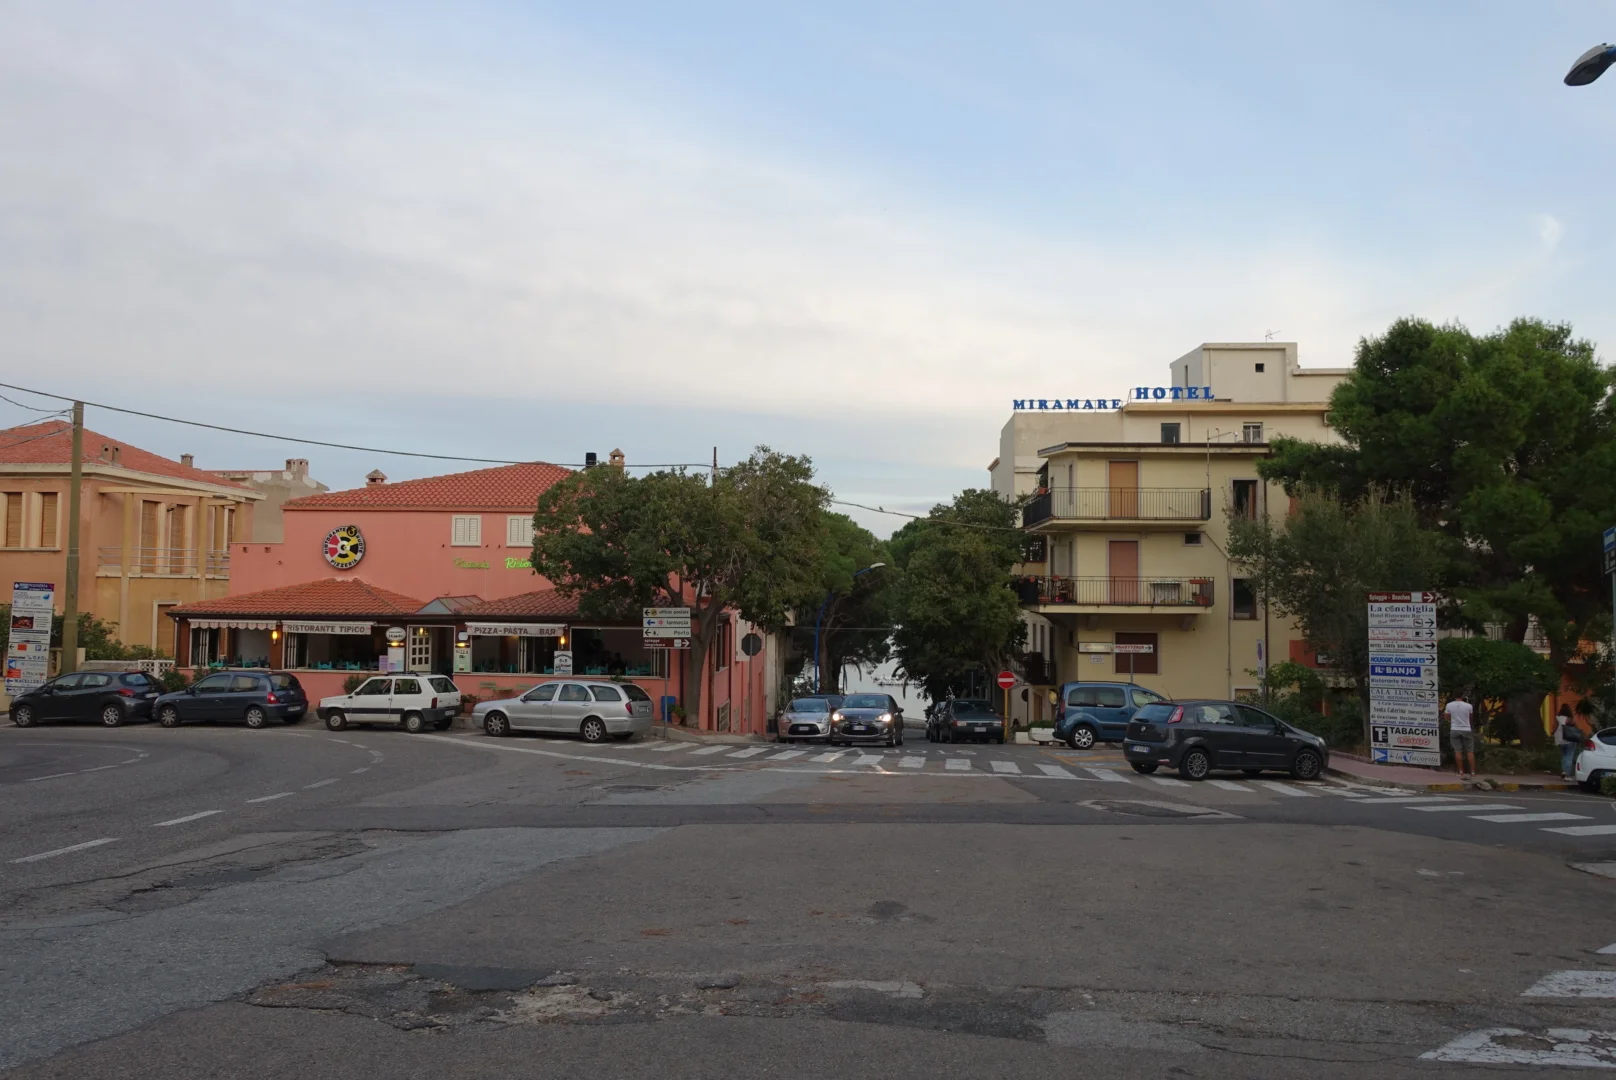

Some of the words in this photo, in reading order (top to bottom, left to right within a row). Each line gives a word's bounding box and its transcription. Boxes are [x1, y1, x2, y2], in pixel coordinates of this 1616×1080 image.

[1136, 386, 1215, 400] HOTEL
[1012, 398, 1122, 410] MIRAMARE
[324, 527, 346, 554] RISTORANTE
[330, 558, 358, 568] PIZZERIA
[1385, 605, 1434, 614] conchiglia
[287, 624, 336, 632] RISTORANTE
[1390, 727, 1437, 736] TABACCHI
